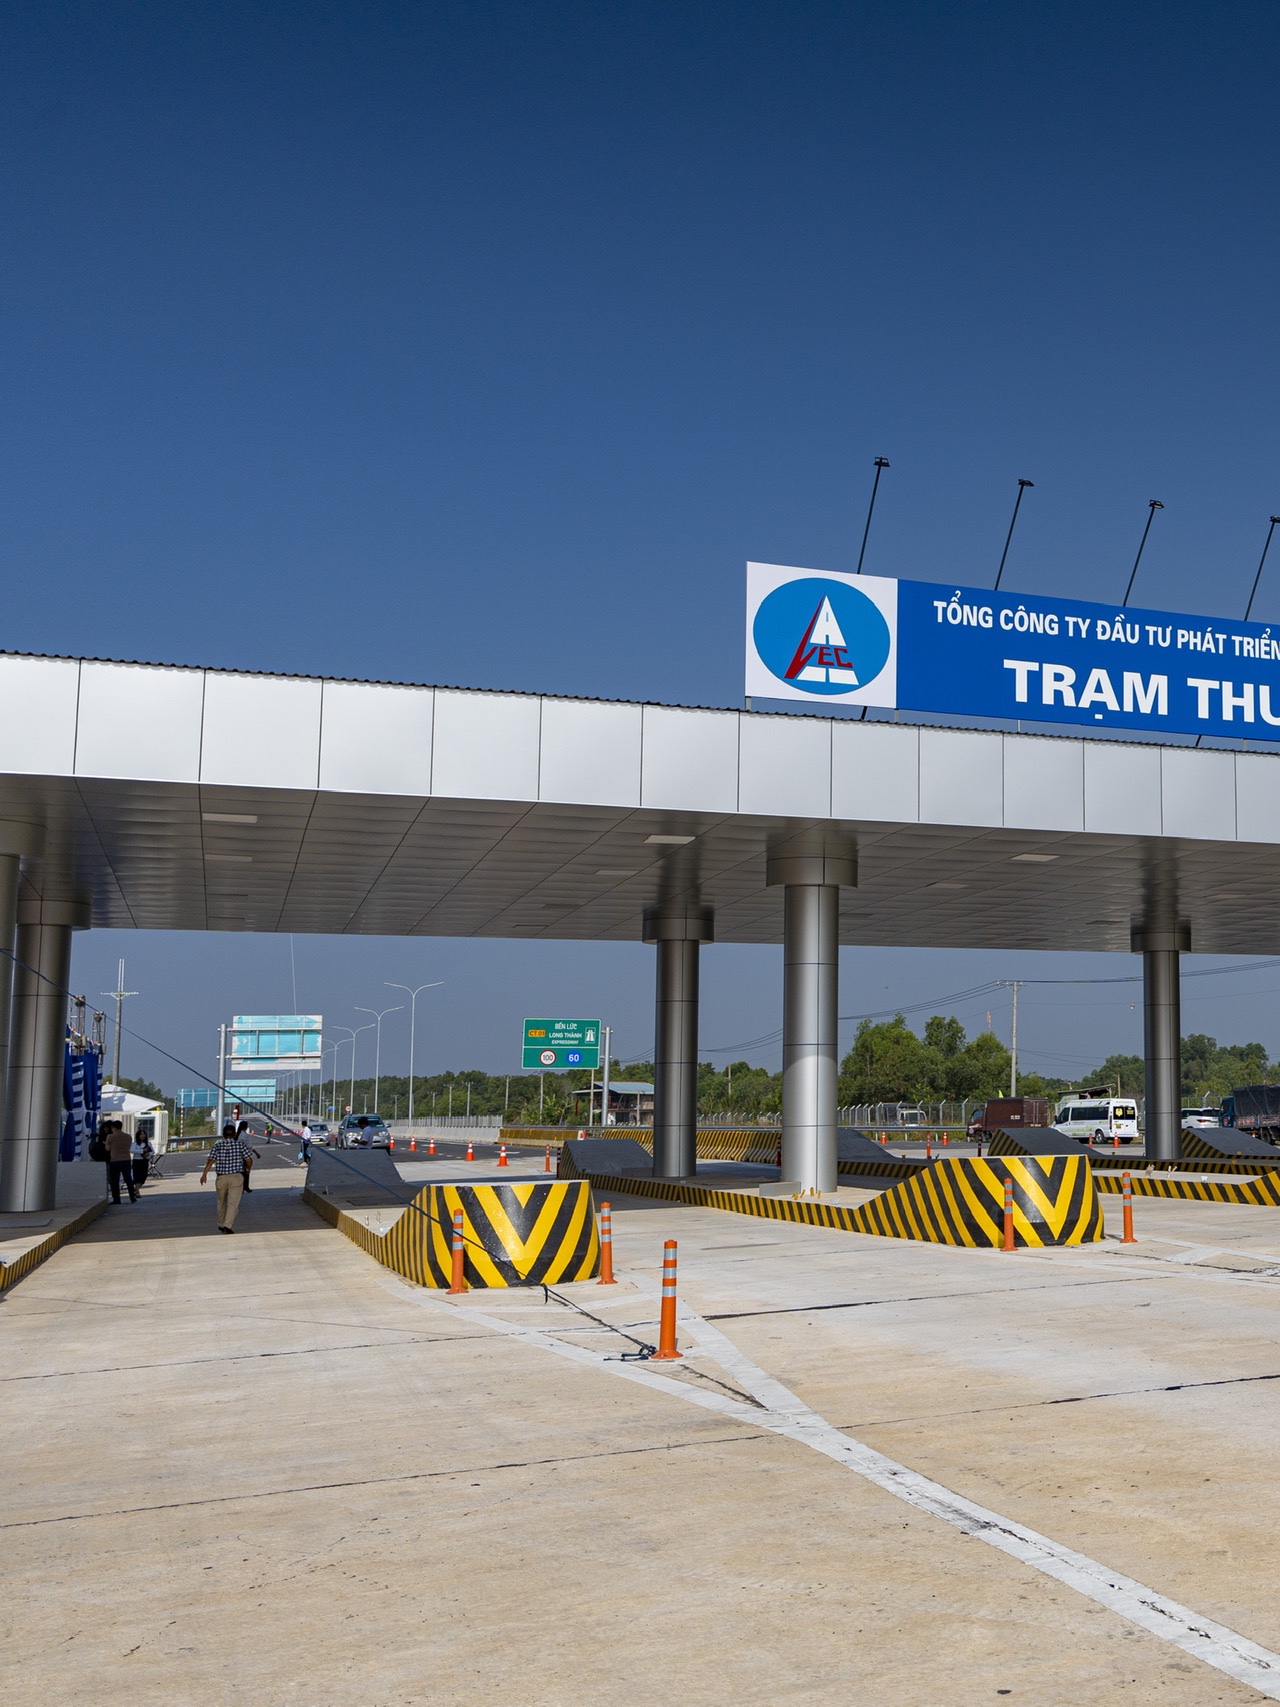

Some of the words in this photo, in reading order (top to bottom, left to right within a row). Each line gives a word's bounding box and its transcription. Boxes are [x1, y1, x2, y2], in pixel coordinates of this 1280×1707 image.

[933, 590, 993, 628] TỔNG
[1000, 606, 1058, 635] CÔNG
[1064, 616, 1091, 637] TY
[1096, 614, 1139, 645] ĐẦU
[1145, 625, 1176, 648] TƯ
[1177, 627, 1227, 655] PHÁT
[1003, 659, 1169, 720] TRẠM
[554, 1022, 566, 1030] BẾN
[566, 1022, 578, 1030] LỨC
[542, 1054, 553, 1062] 100
[568, 1054, 579, 1062] 60
